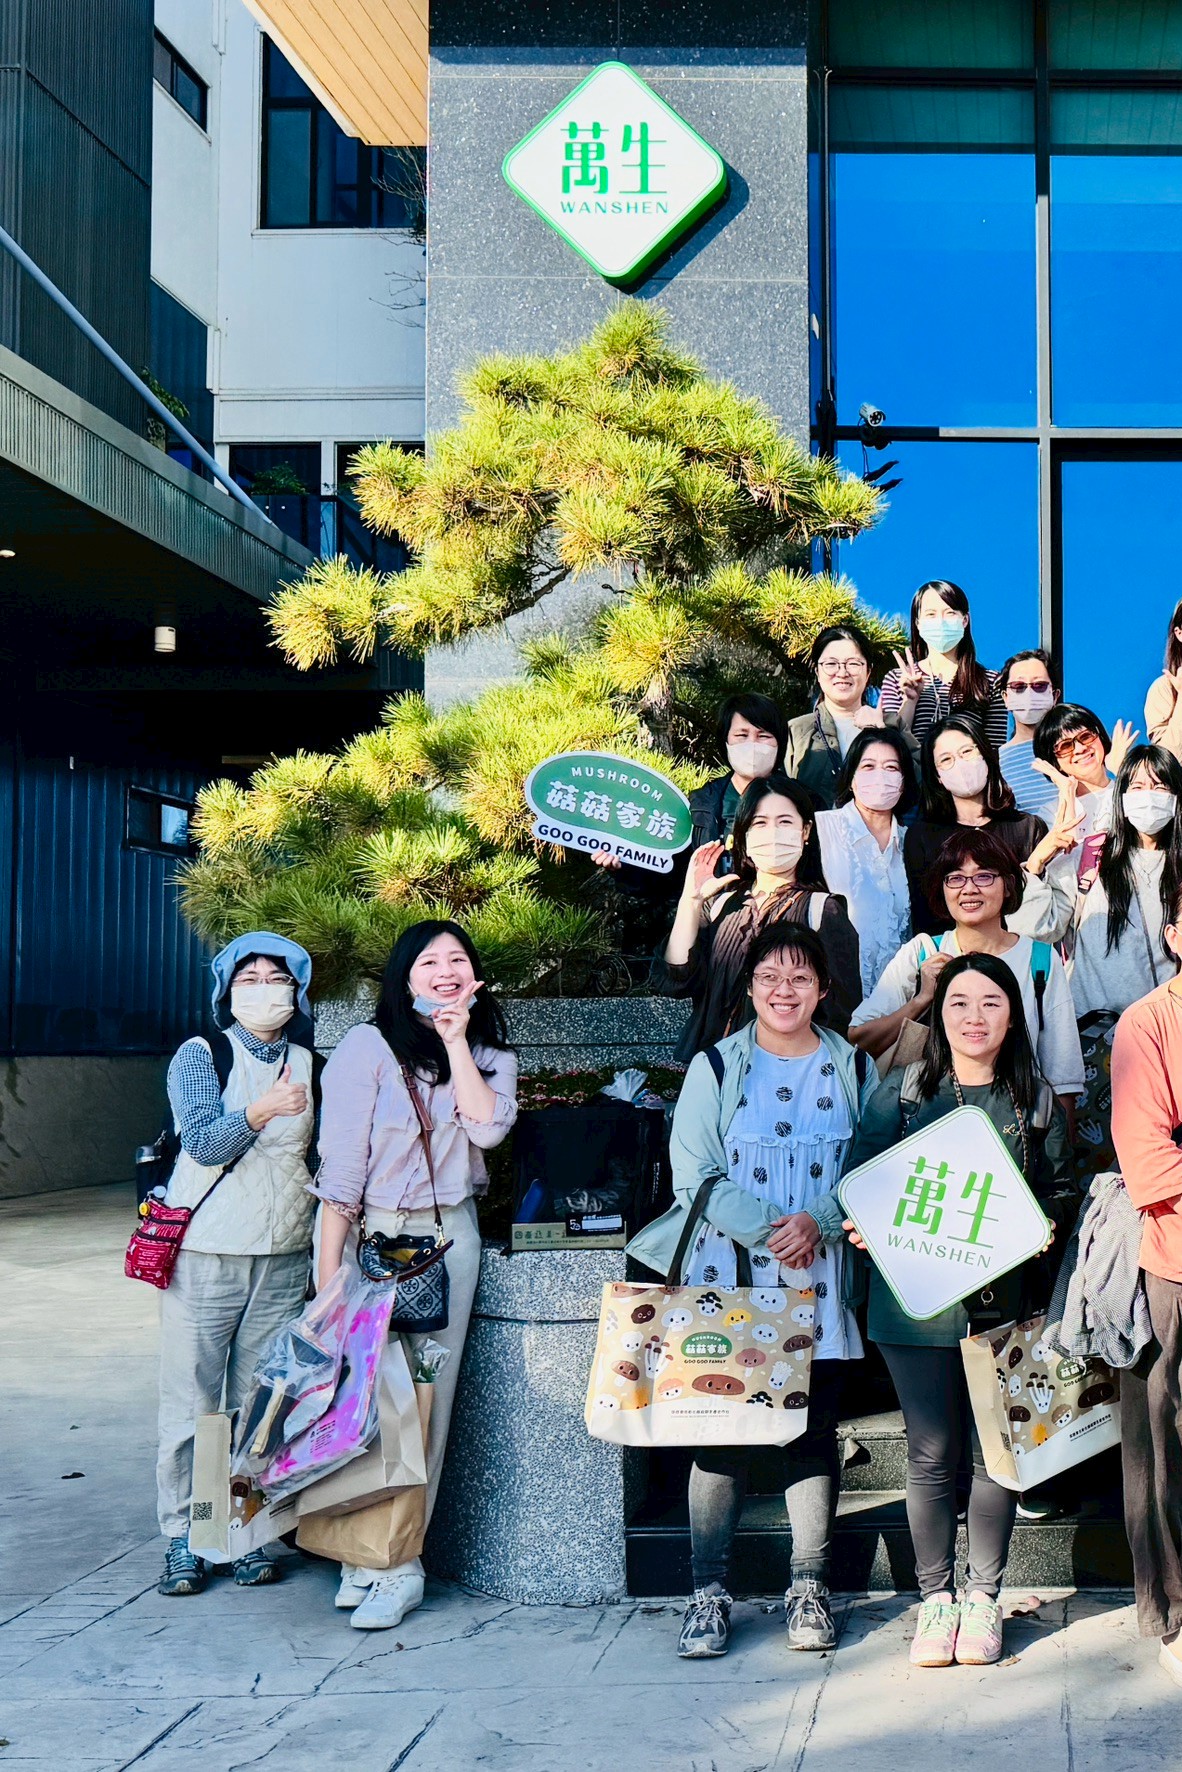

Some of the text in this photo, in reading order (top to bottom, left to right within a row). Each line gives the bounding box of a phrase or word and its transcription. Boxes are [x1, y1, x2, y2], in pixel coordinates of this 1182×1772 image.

[560, 121, 668, 194] 萬生
[560, 201, 669, 214] WANSHEN
[571, 766, 663, 802] MUSHROOM
[546, 780, 677, 841] 菇菇家族
[538, 824, 669, 869] GOO GOO FAMILY
[892, 1155, 1007, 1249] 萬生
[887, 1233, 992, 1269] WANSHEN
